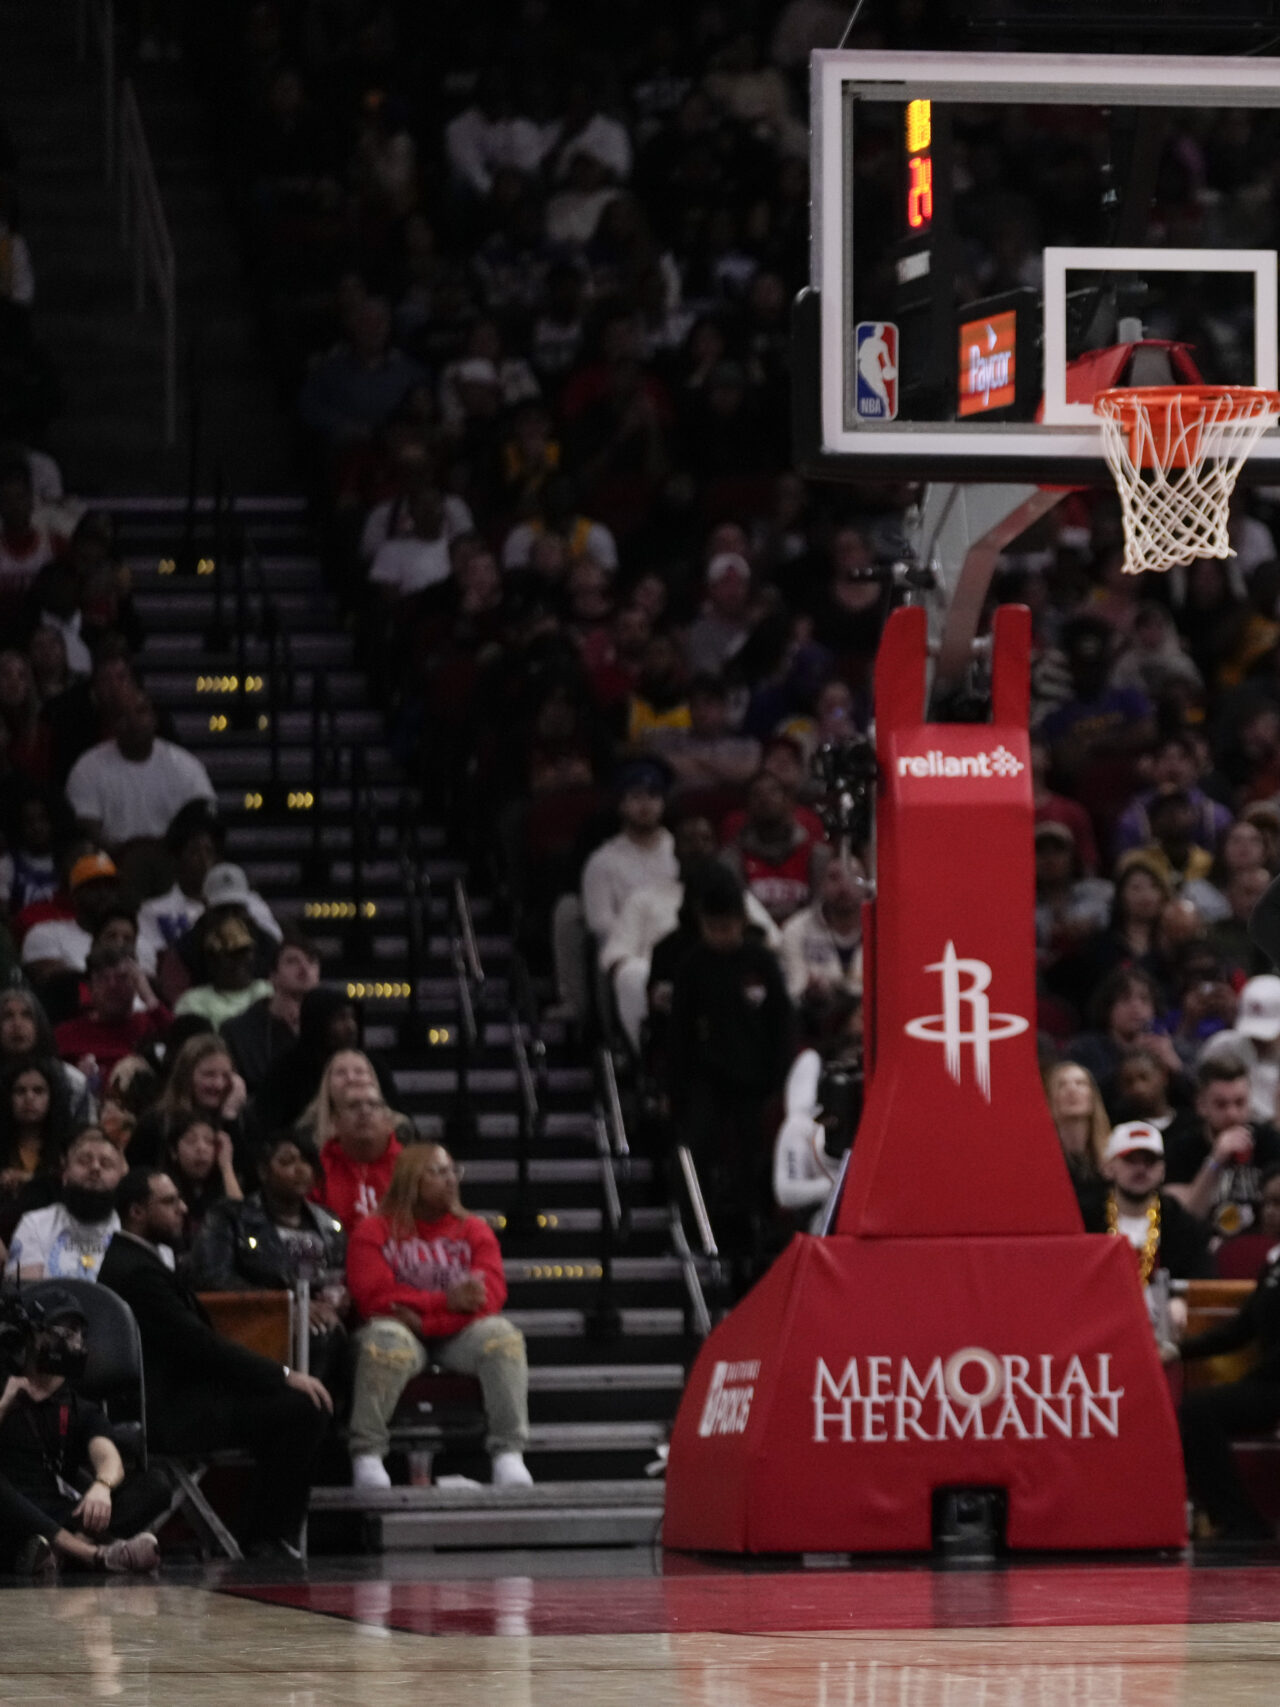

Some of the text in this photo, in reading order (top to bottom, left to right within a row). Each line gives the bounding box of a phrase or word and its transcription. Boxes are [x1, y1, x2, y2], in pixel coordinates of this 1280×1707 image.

[969, 345, 1012, 406] Paycor
[861, 397, 882, 414] NBA
[898, 751, 993, 778] reliant
[812, 1347, 1125, 1406] MEMORIAL
[812, 1394, 1119, 1442] HERMANN
